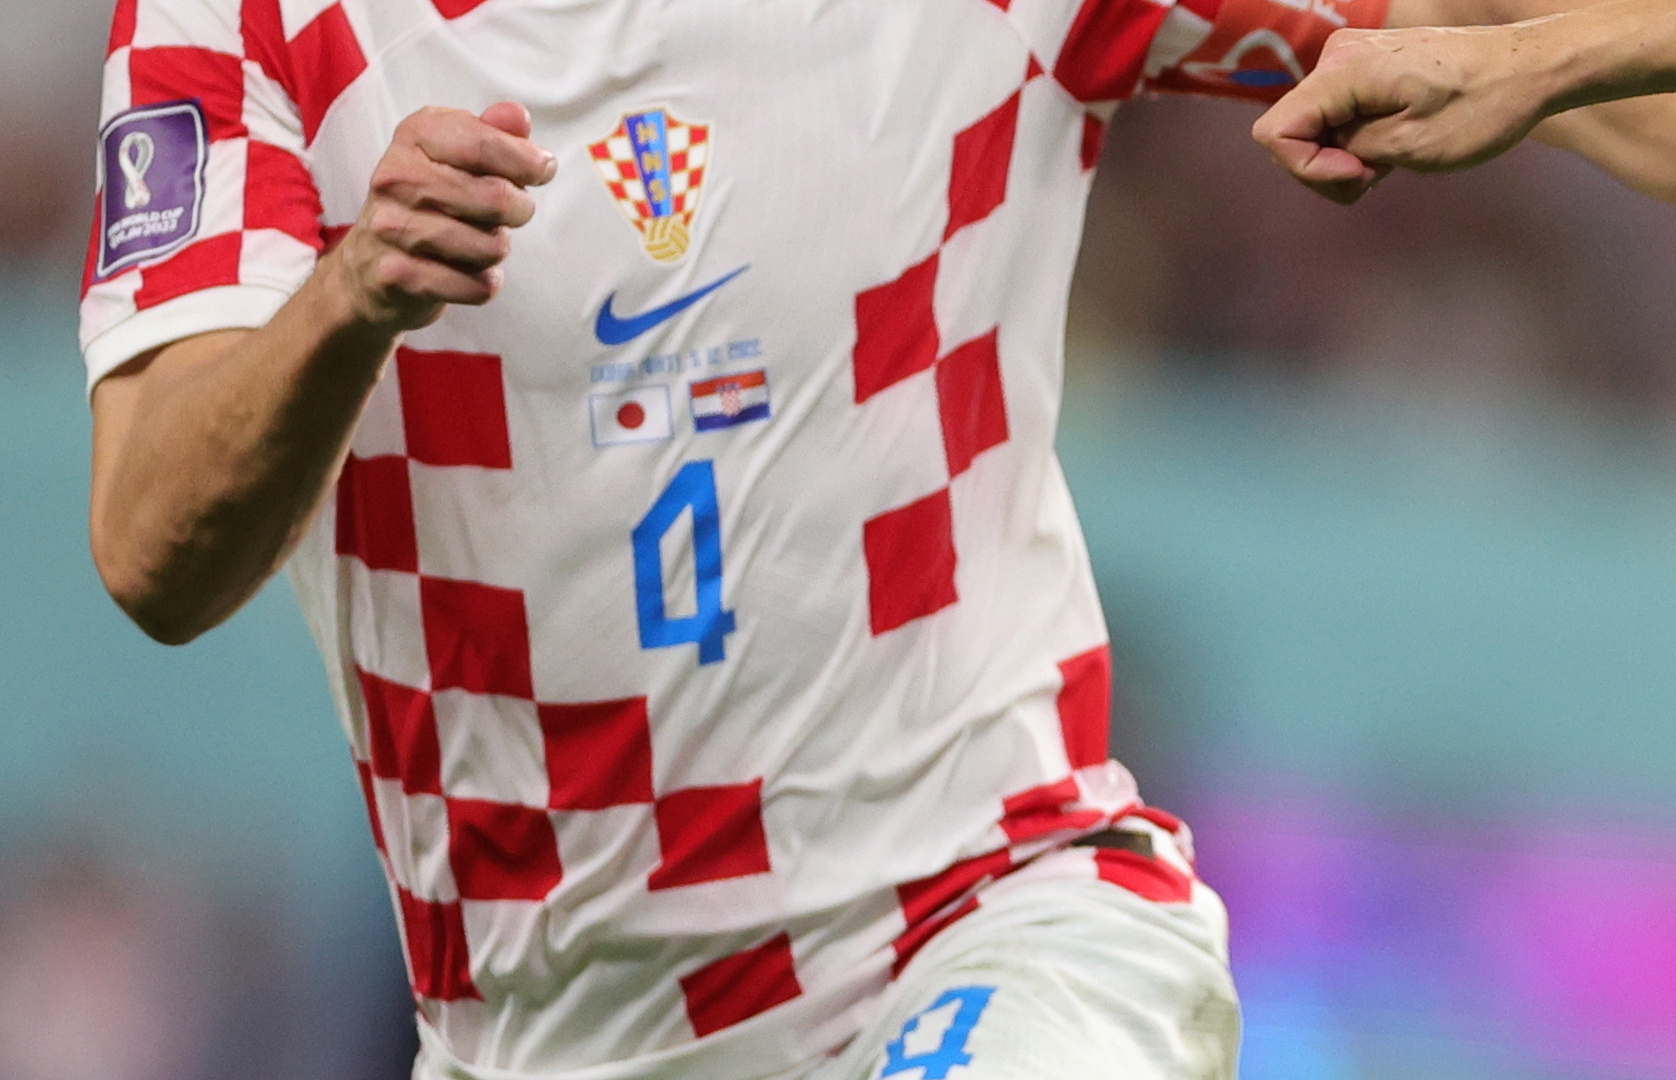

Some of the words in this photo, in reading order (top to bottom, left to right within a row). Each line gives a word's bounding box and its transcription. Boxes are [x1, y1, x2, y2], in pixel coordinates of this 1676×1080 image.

[635, 120, 666, 203] HNS
[631, 459, 736, 666] 4
[881, 984, 998, 1080] 4
